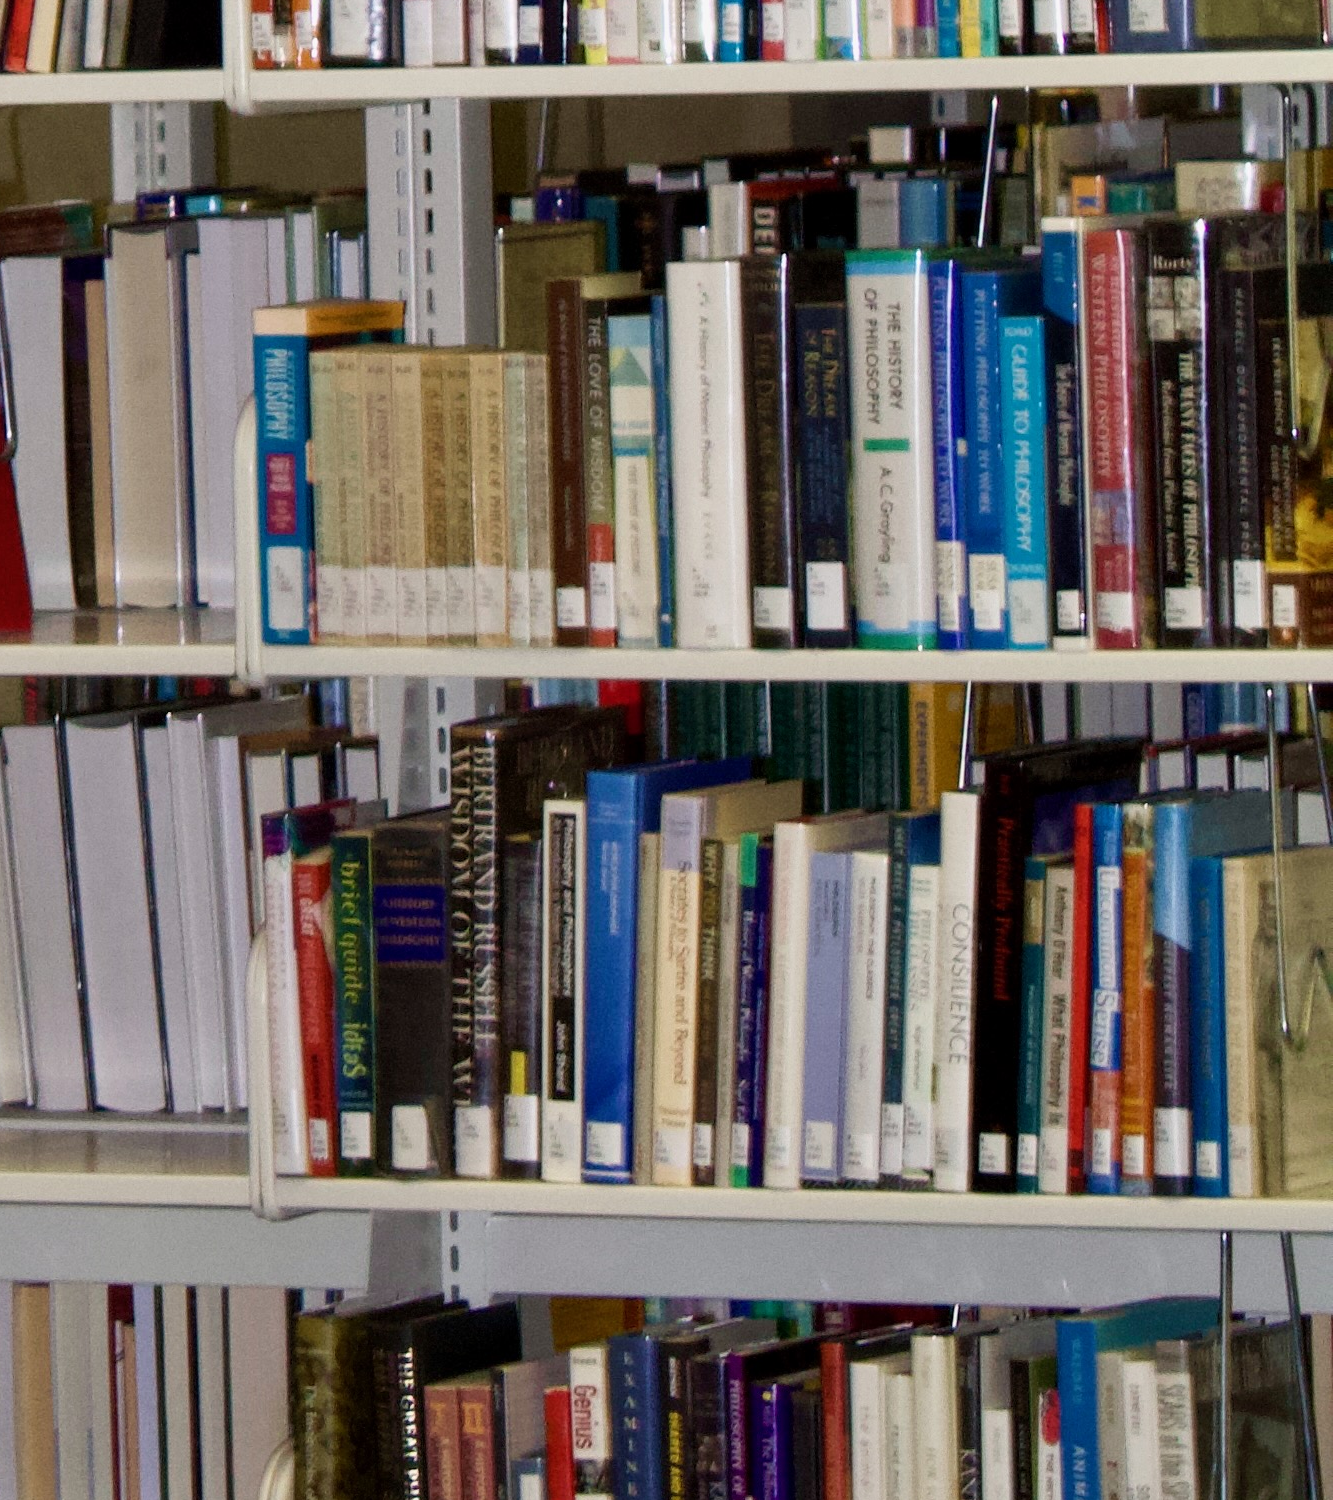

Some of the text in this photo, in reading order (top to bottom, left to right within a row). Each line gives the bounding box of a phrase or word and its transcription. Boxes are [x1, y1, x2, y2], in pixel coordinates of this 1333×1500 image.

[263, 349, 289, 440] PHILOSOPHY
[864, 289, 881, 424] OF PHILOSOPHY
[888, 302, 904, 409] THE HISTORY
[1091, 254, 1111, 476] WESTERN PHILOSOPHY
[587, 316, 603, 512] THE LOVE OF WISDOM
[1011, 345, 1032, 552] GUIDE TO PHILOSOPHY
[878, 500, 894, 562] Grayling
[915, 701, 927, 806] EXPERIMENTS
[341, 861, 363, 926] brief
[452, 746, 472, 1043] WISDOM OF THE
[473, 746, 497, 1049] BERTRAND RUSSELL
[704, 846, 716, 882] WHY
[703, 927, 717, 979] THINK
[993, 819, 1014, 1000] Practically Profound
[1053, 887, 1067, 936] Anthony
[339, 933, 363, 1003] guide
[672, 860, 690, 1085] Socrates to Sartre and Beyond
[948, 904, 969, 1064] CONSILIENCE
[1055, 995, 1066, 1028] What
[1093, 869, 1117, 1066] Uncommon Sense
[1050, 1033, 1065, 1108] Philosophy
[400, 1348, 414, 1389] THE
[402, 1394, 417, 1462] GREAT
[575, 1384, 597, 1449] Genius
[730, 1380, 743, 1469] PHILOSOPHY
[732, 1476, 743, 1495] OF
